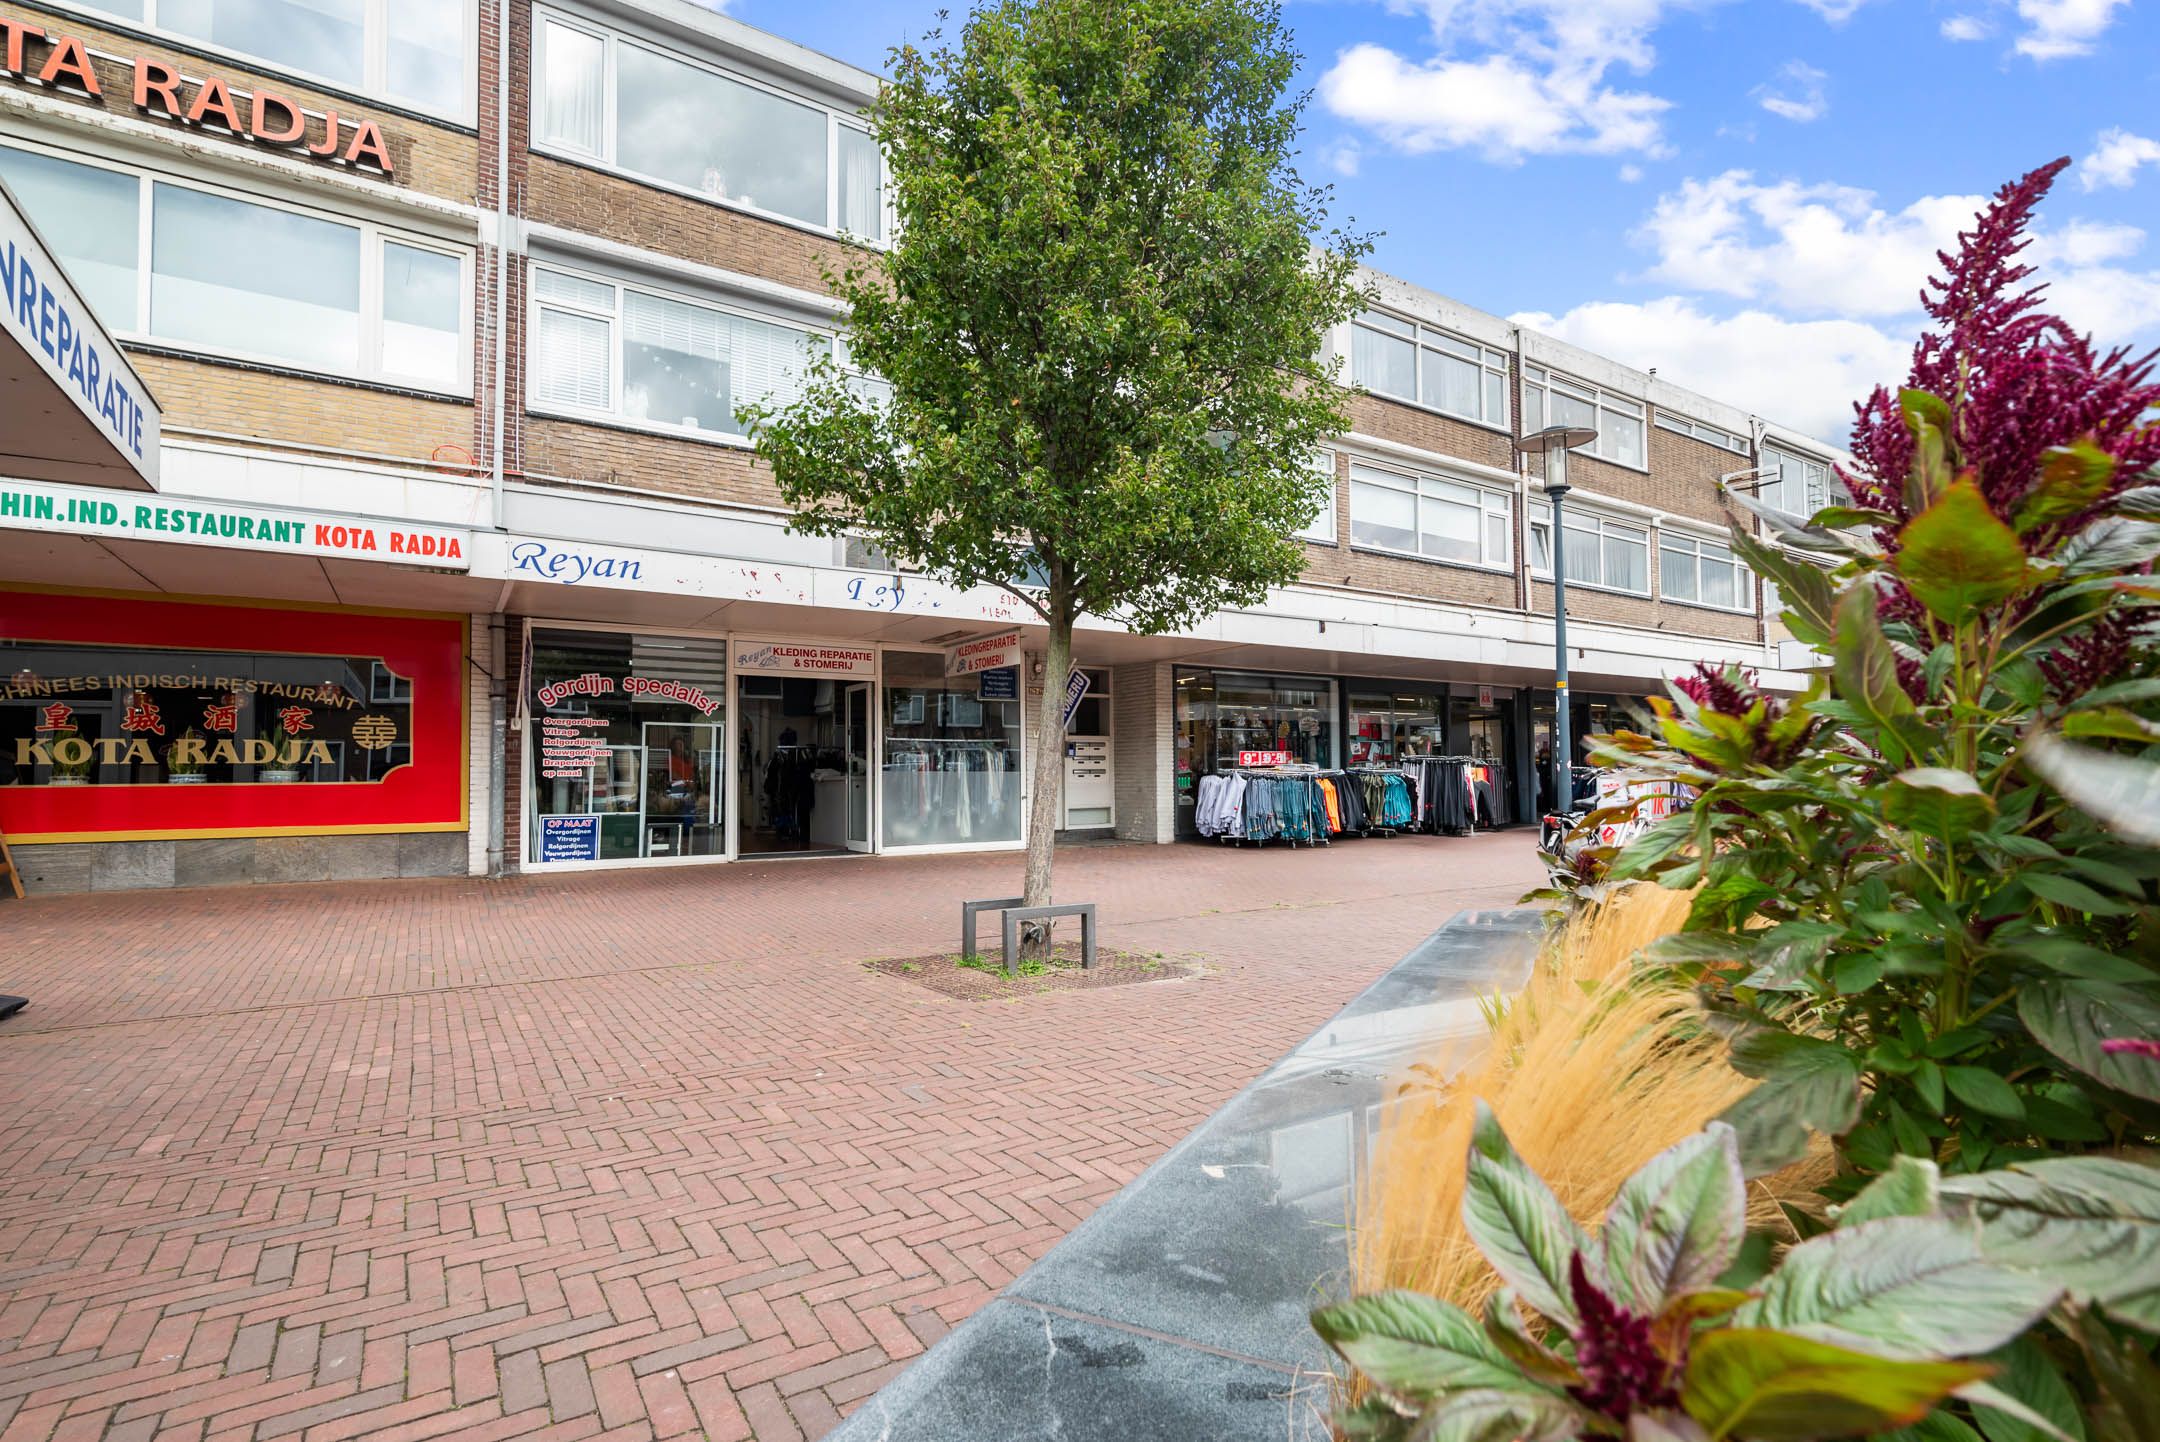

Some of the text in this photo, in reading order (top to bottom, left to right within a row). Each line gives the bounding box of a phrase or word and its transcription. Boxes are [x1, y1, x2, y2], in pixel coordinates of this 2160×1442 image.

[0, 17, 394, 173] TA RADJA
[135, 505, 305, 544] RESTAURANT
[315, 524, 377, 551] KOTA
[390, 532, 462, 559] RADJA
[512, 542, 643, 584] Reyan
[958, 634, 1017, 657] KLEDINGREPARATIE
[773, 647, 817, 659] KLEDING
[820, 649, 873, 662] REPARATIE
[794, 659, 853, 670] & STOMERIJ
[108, 674, 207, 690] INDISCH
[214, 677, 359, 711] RESTAURANT
[538, 673, 721, 717] gordijn specialist
[543, 717, 609, 727] Overgordijnen
[543, 727, 580, 737] Vitrage
[543, 738, 603, 748] Rolgordijnen
[15, 737, 335, 766] KOTA RADJA
[543, 748, 613, 758] Vouwgordijnen
[543, 768, 582, 778] op maat
[547, 820, 593, 828] OP MAAT
